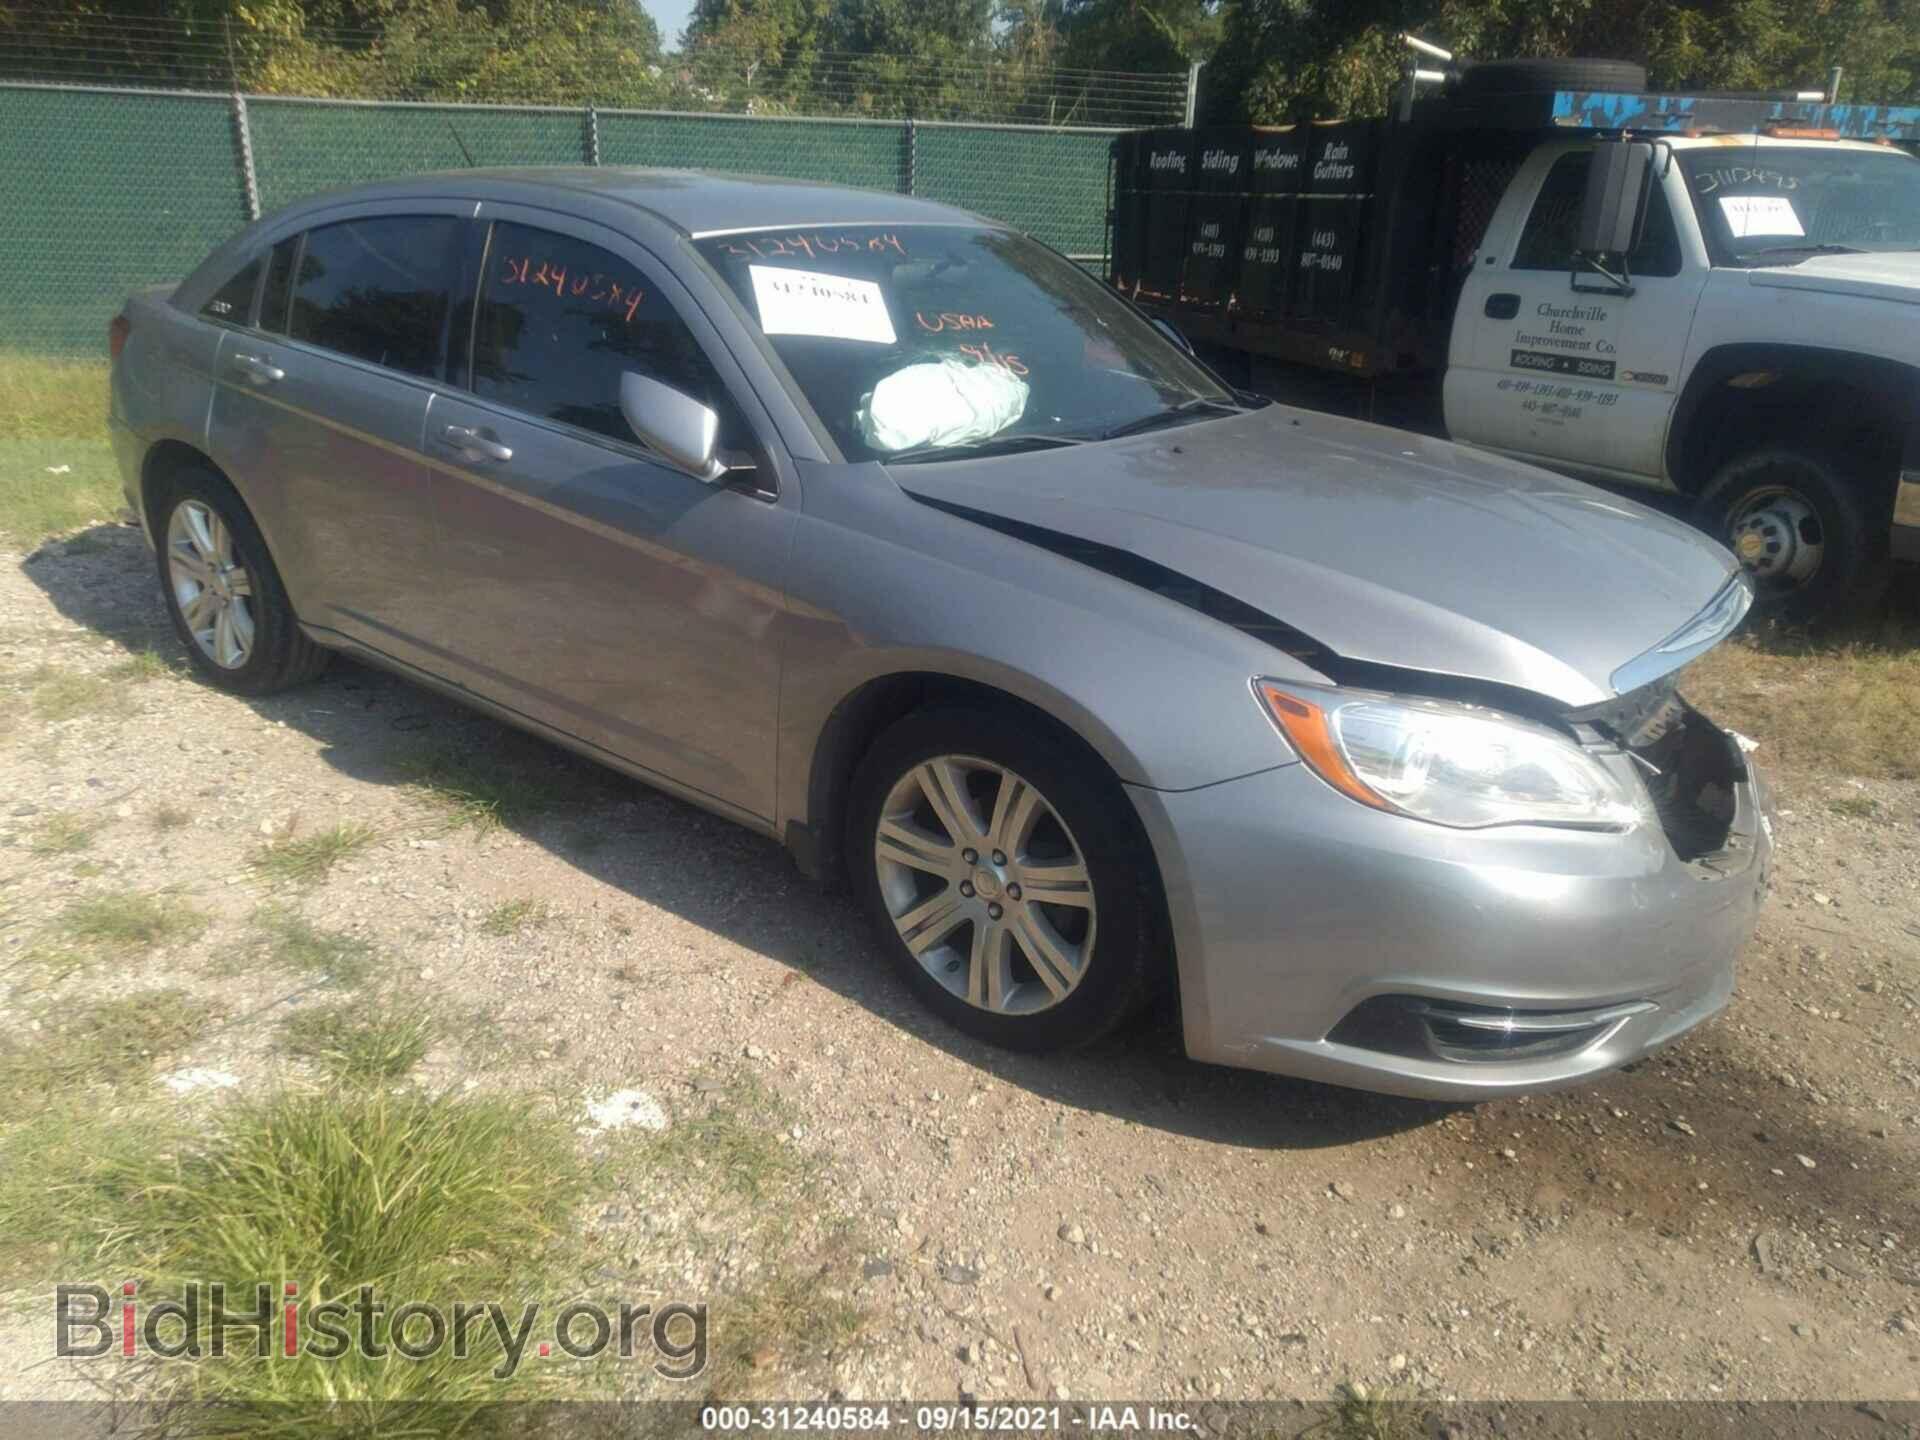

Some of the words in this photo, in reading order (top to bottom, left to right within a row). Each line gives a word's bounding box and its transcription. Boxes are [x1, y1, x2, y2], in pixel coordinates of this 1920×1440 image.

[1323, 141, 1349, 160] Rain
[1201, 149, 1239, 174] Siding
[1313, 160, 1355, 180] Gutters
[1311, 231, 1336, 249] (443)
[915, 311, 994, 333] USAA
[1536, 302, 1608, 322] Churchville
[1549, 319, 1586, 338] Home
[1514, 330, 1592, 353] Improvement
[1595, 340, 1617, 354] Co.
